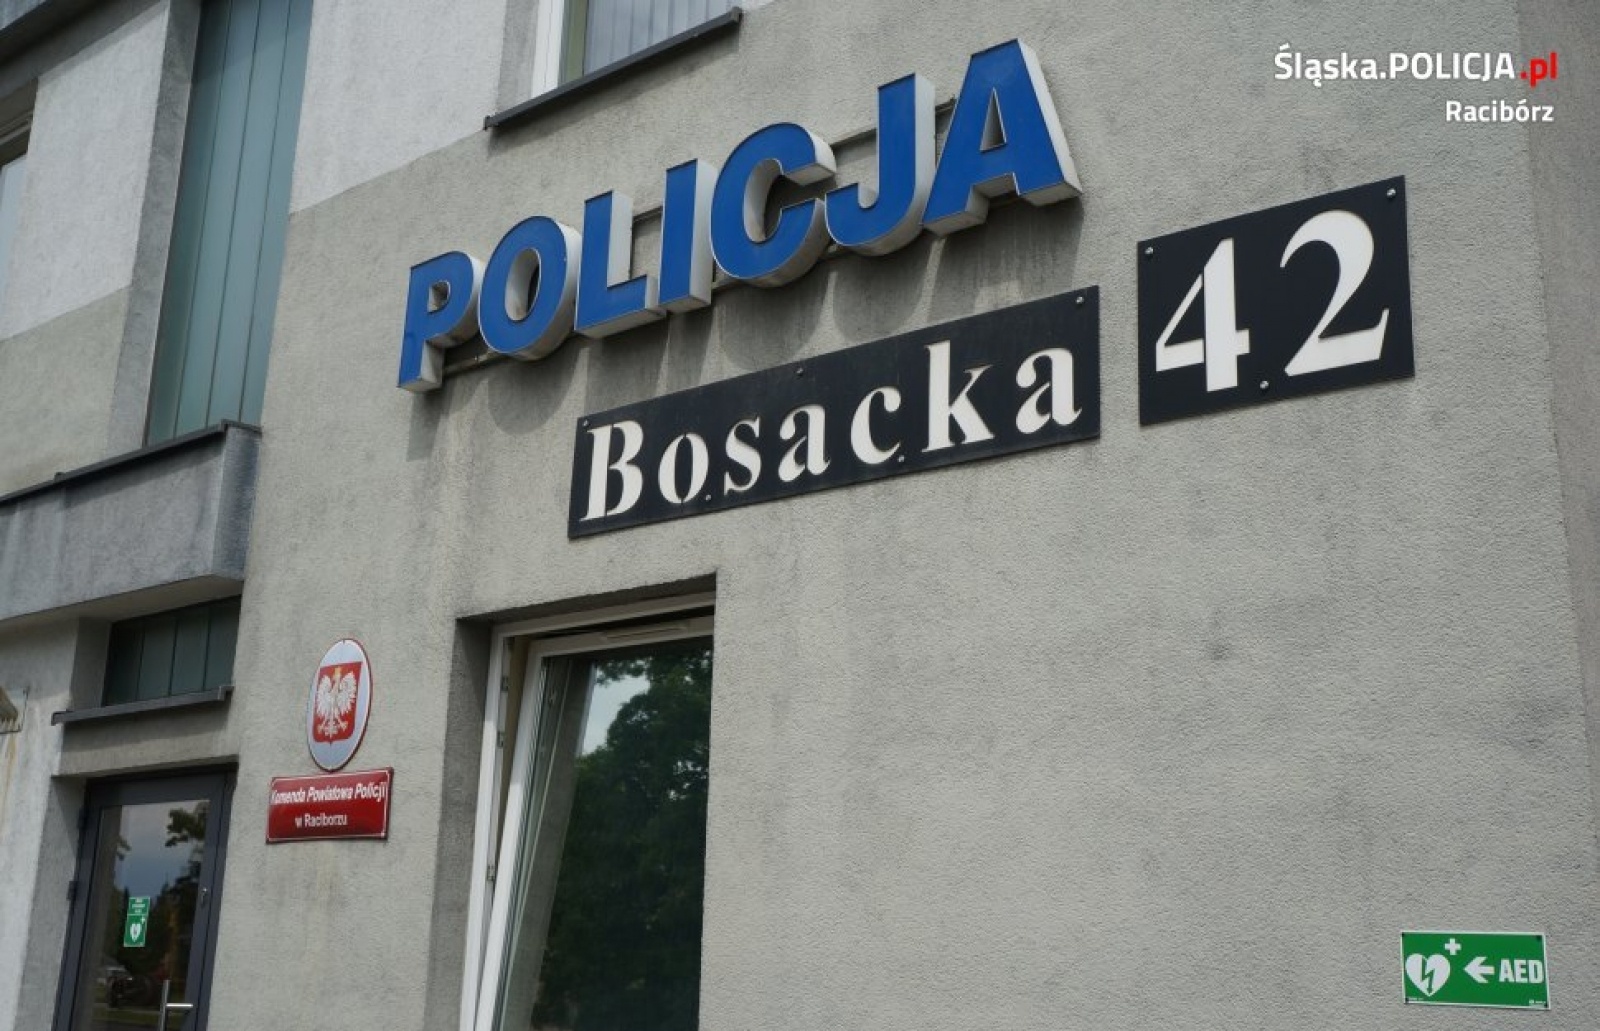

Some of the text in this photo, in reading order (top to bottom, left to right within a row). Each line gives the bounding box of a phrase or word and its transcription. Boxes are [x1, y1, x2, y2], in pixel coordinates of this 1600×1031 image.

[399, 39, 1081, 391] POLICJA
[579, 209, 1389, 522] Bosacka 42
[306, 785, 353, 802] Powiatowa
[354, 782, 386, 802] Policji
[295, 813, 347, 828] w Raciborzu
[1499, 959, 1544, 983] AED
